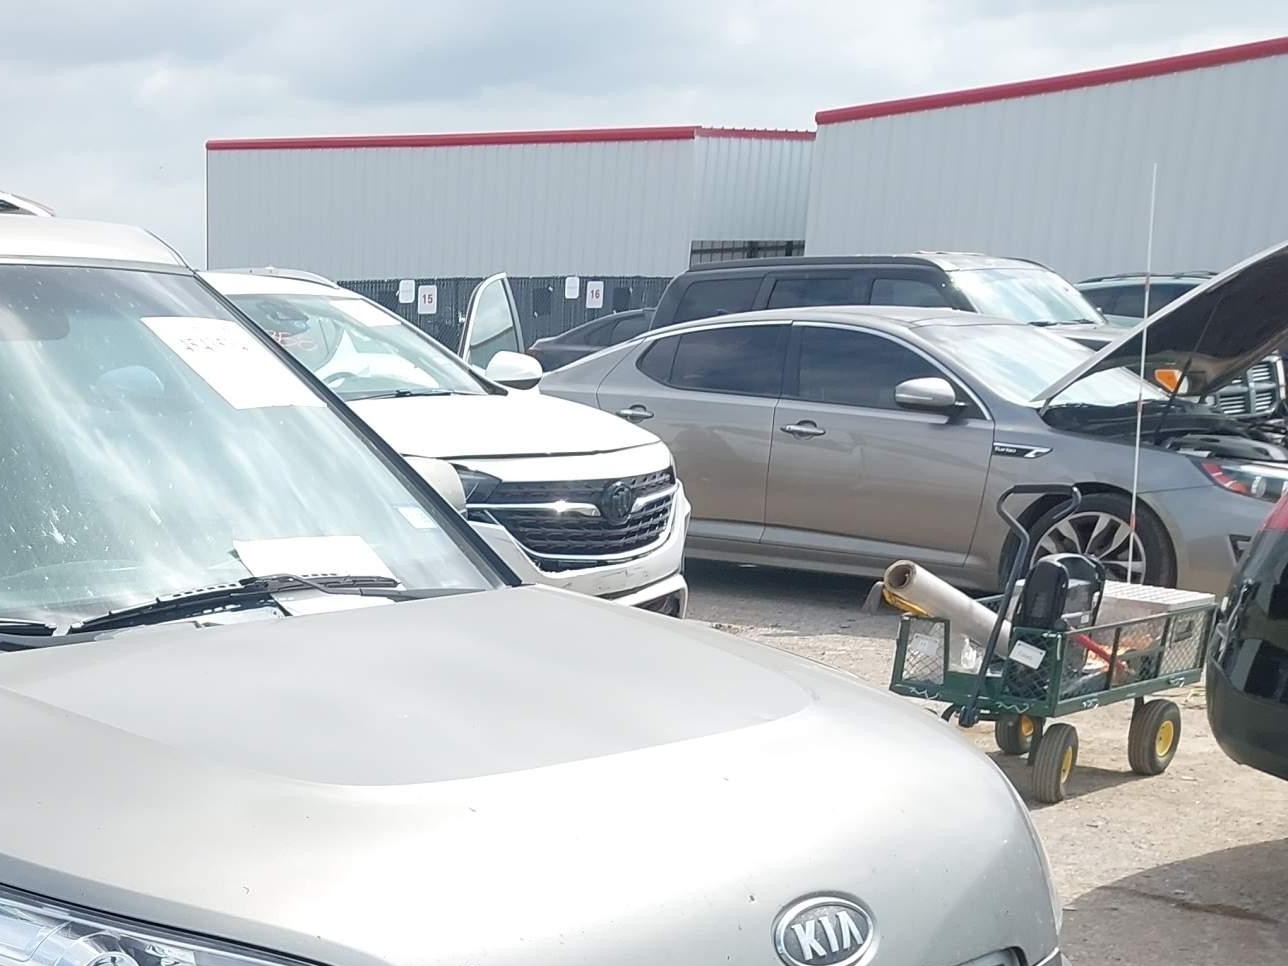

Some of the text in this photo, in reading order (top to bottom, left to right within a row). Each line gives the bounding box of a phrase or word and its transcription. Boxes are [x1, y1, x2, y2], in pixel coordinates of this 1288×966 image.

[422, 294, 433, 304] 15
[590, 289, 600, 299] 16
[791, 908, 864, 961] KIA
